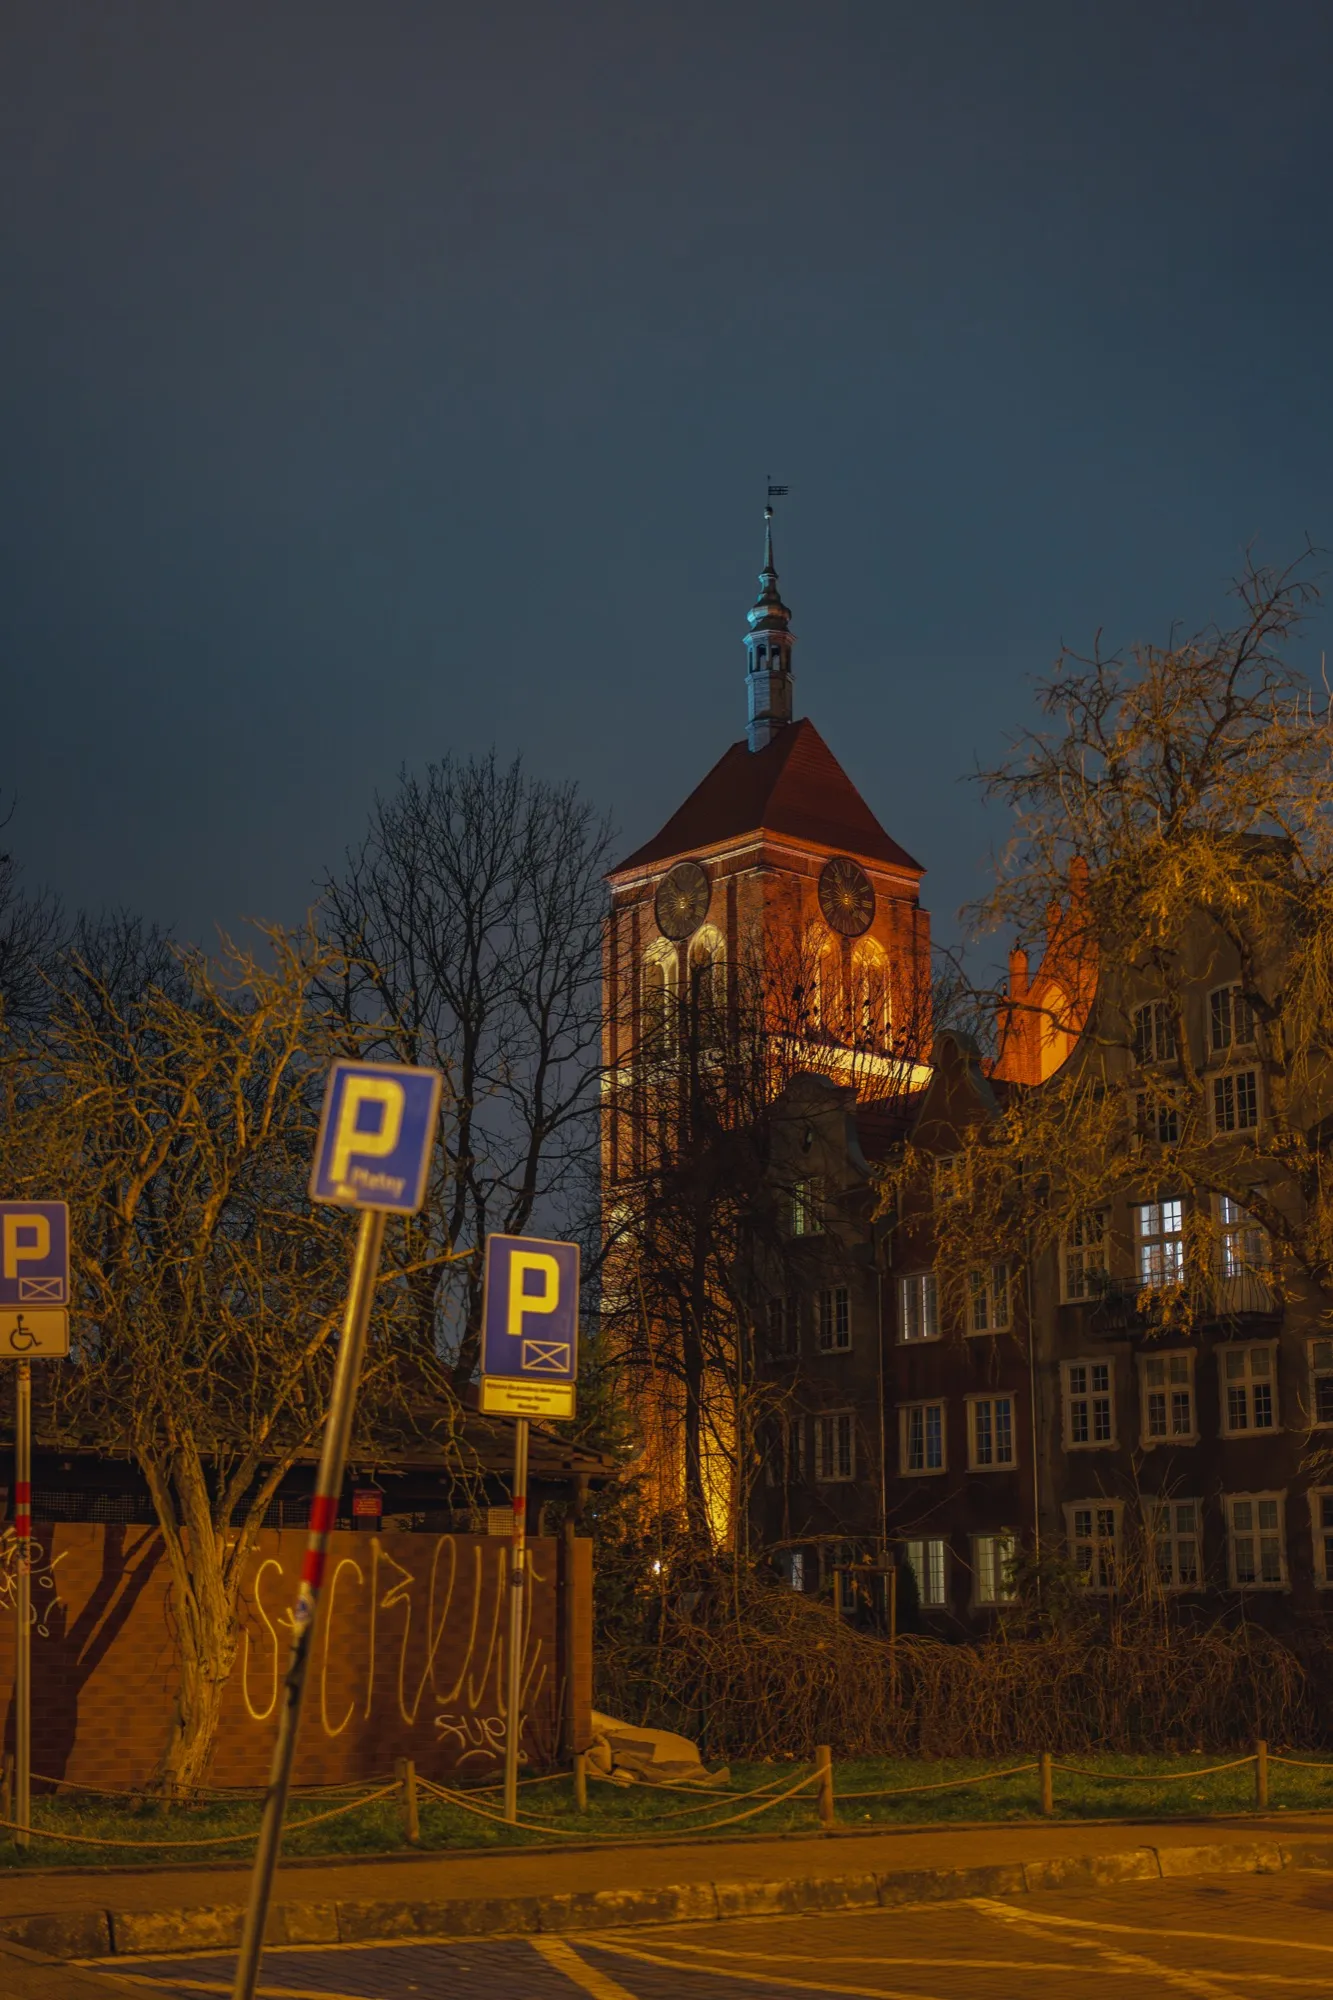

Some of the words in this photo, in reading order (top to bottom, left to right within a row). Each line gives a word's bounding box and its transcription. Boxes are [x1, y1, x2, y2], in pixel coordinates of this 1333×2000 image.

[329, 1074, 406, 1182] P
[3, 1213, 51, 1279] P
[506, 1250, 560, 1337] P
